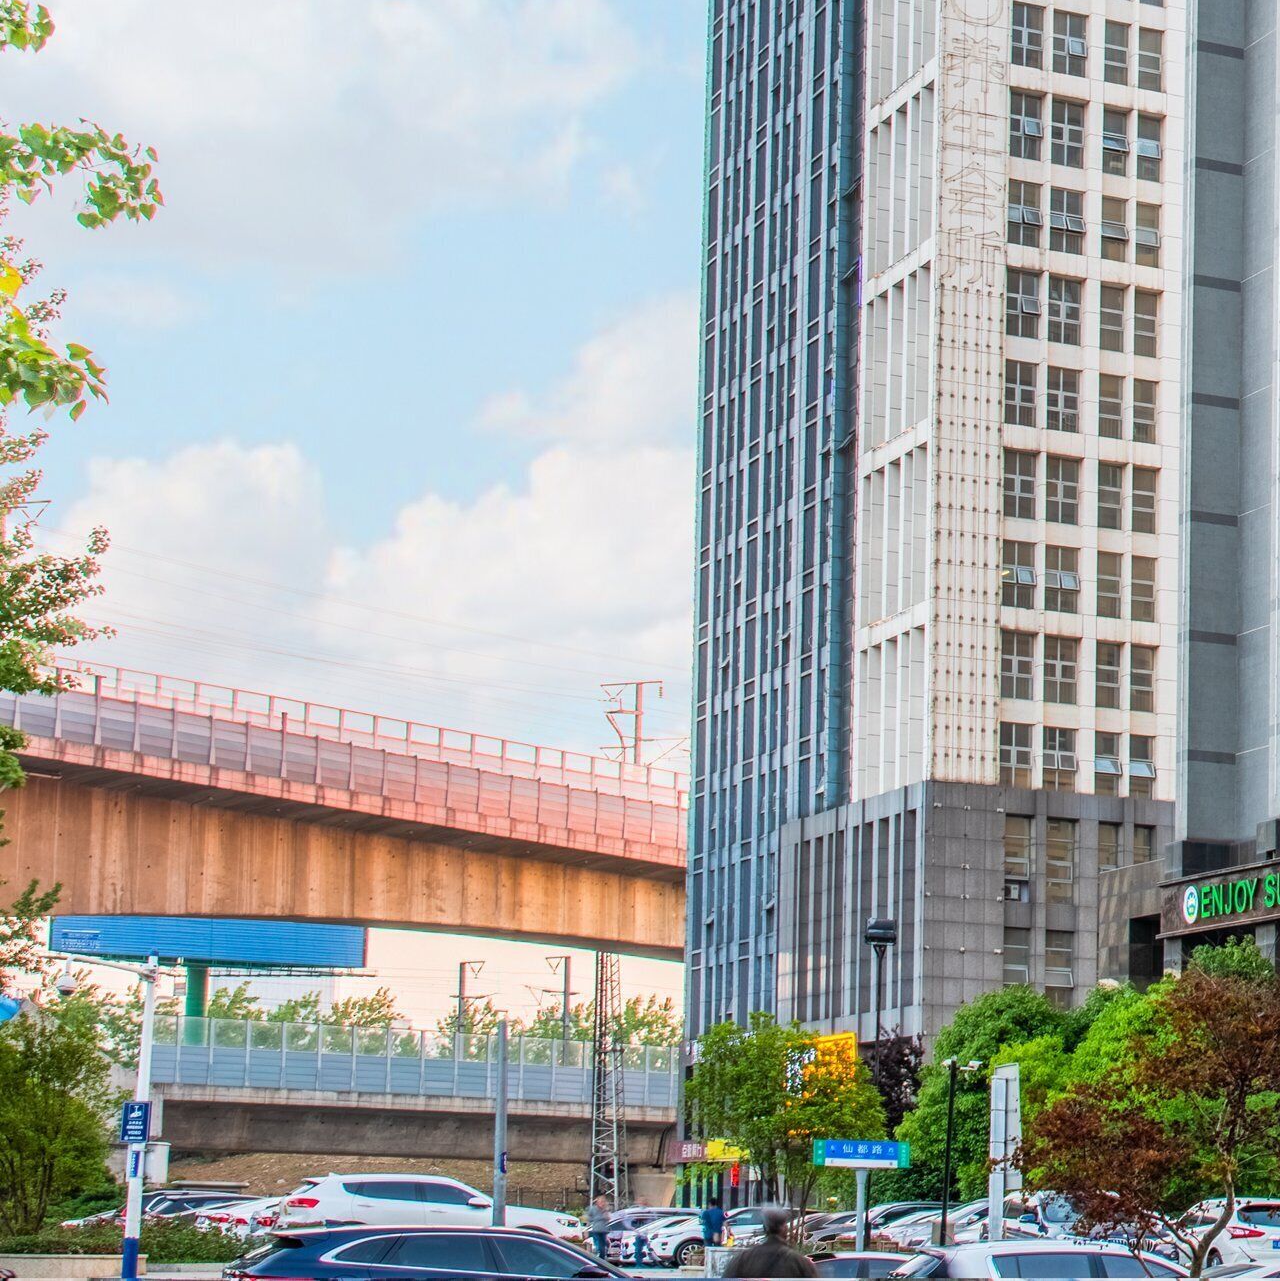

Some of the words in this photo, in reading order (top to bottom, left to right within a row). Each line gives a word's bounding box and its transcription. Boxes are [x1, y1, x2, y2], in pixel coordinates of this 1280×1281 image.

[1201, 878, 1259, 919] ENJOY
[843, 1143, 883, 1155] 仙都路
